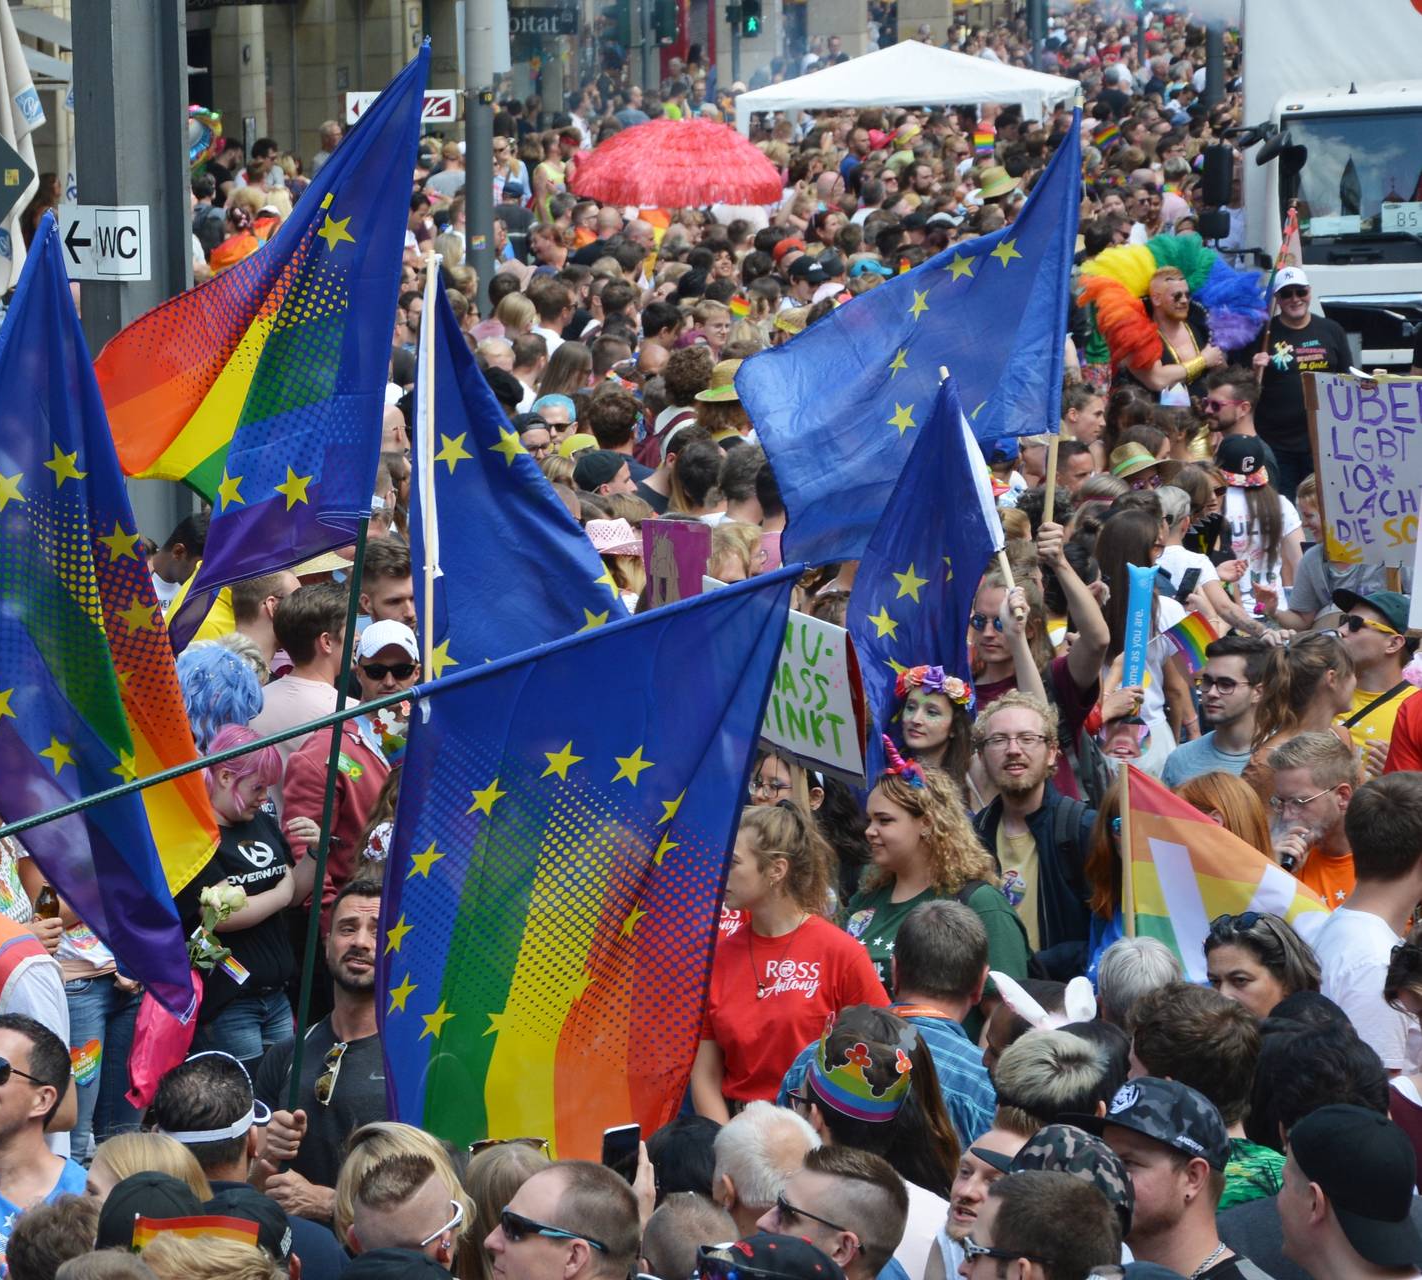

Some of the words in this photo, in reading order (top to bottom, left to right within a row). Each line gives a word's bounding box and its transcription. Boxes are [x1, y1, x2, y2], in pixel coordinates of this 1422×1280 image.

[98, 226, 138, 259] WC
[1332, 426, 1416, 463] LGBT
[1242, 456, 1255, 473] C
[1336, 518, 1375, 544] DIE
[1135, 608, 1145, 628] are.
[1132, 629, 1143, 651] you
[1131, 650, 1140, 662] as
[1129, 664, 1139, 687] ome
[765, 694, 846, 757] INKT
[766, 960, 820, 980] ROSS
[764, 975, 822, 999] Antony
